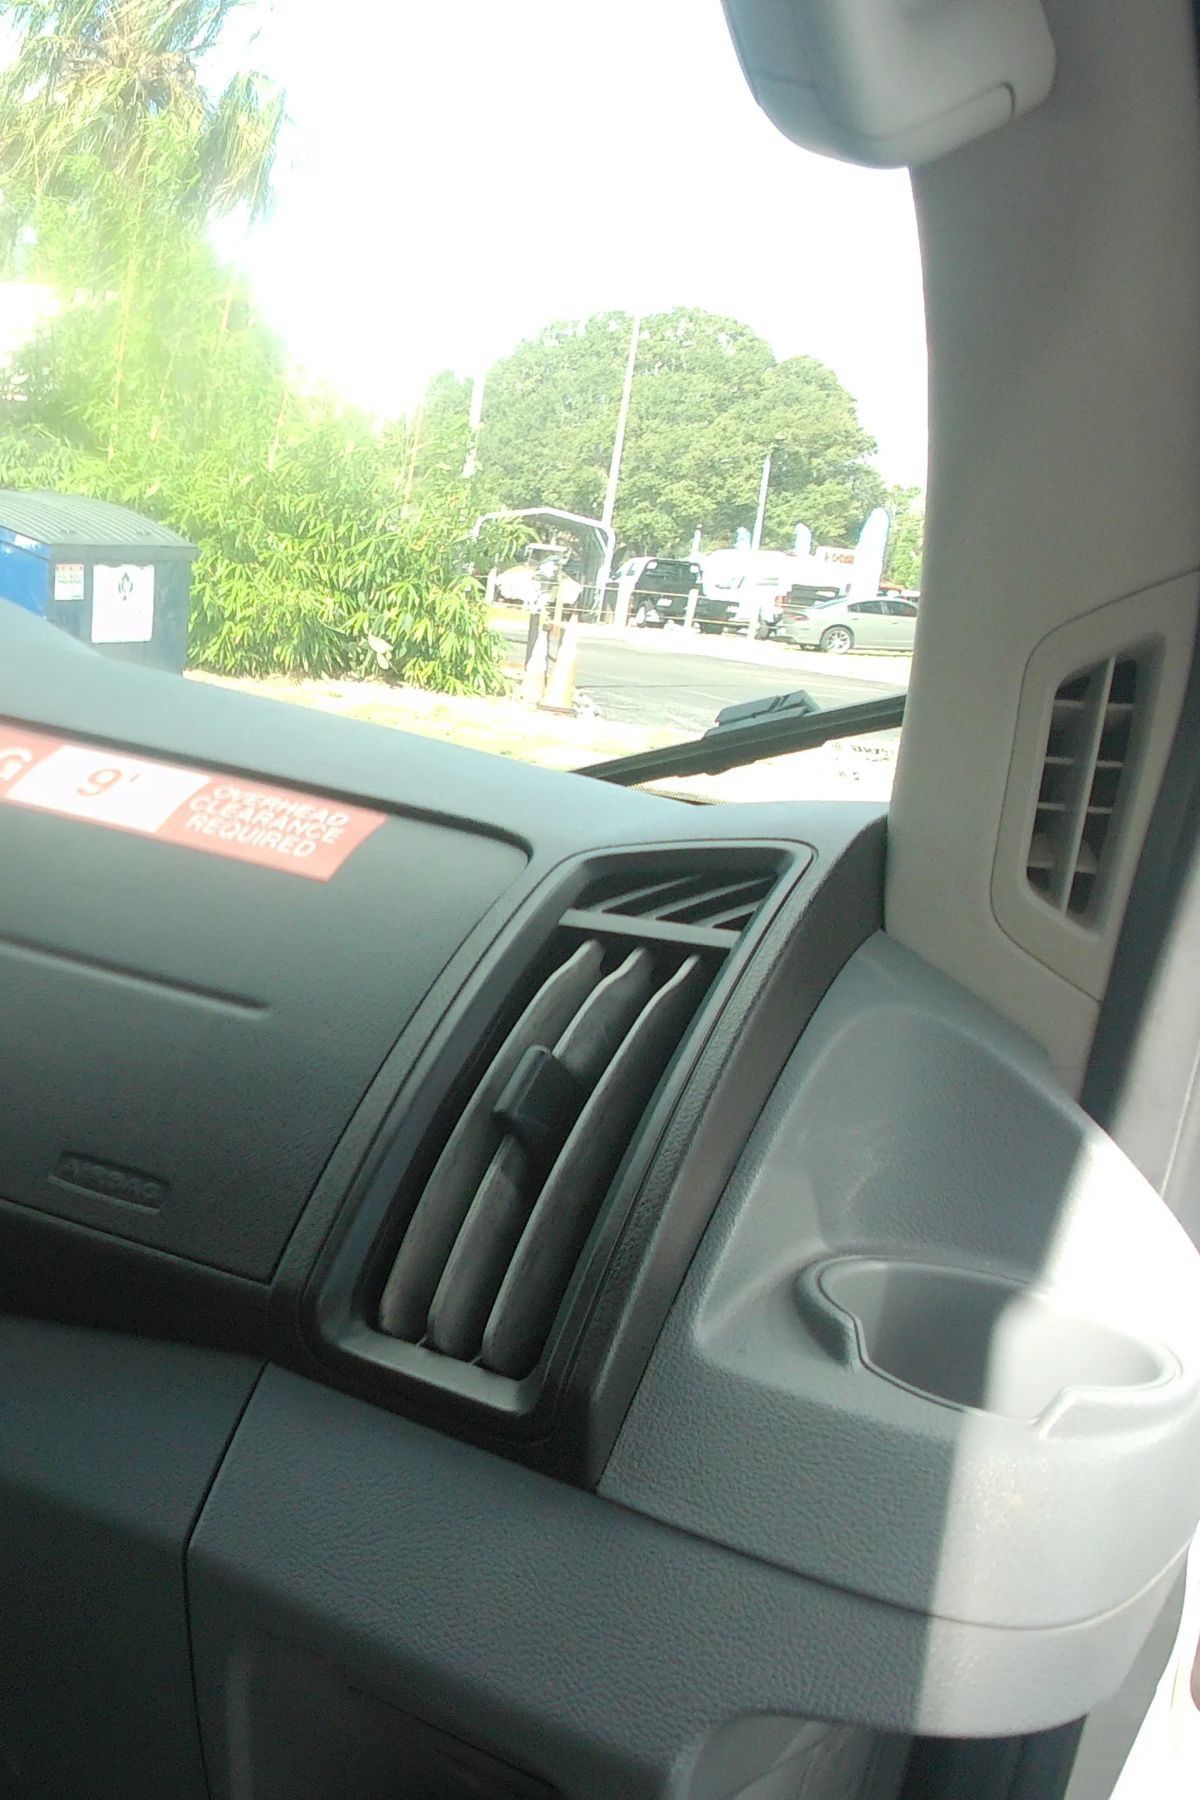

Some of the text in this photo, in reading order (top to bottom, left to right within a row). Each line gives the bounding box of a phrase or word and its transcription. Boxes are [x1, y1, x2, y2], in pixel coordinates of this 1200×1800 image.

[189, 796, 344, 844] CLEARANCE
[214, 785, 349, 827] OVERHEAD
[185, 814, 316, 858] REQUIRED
